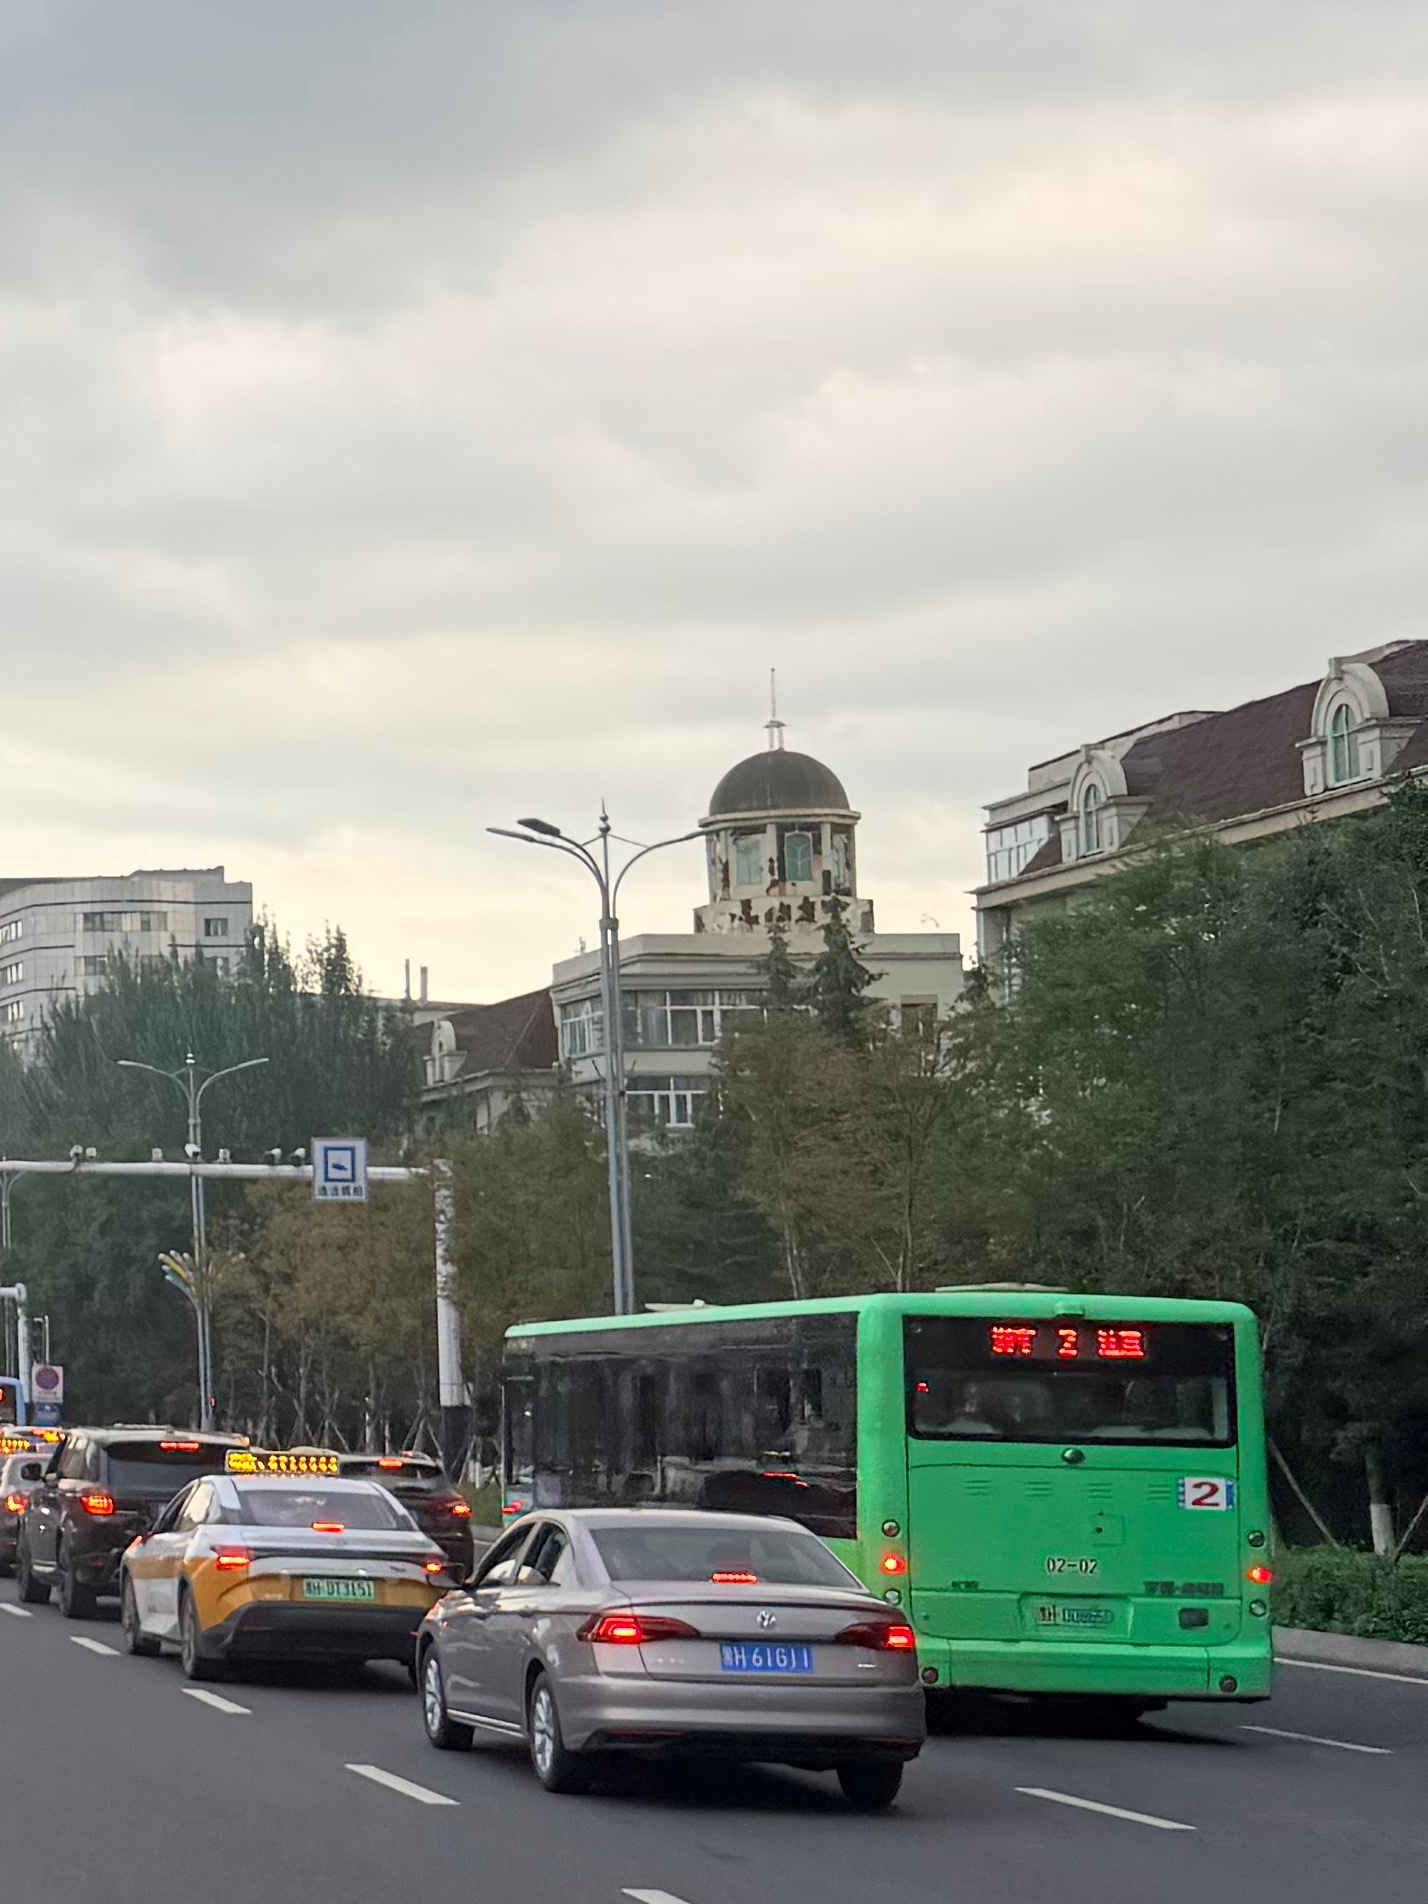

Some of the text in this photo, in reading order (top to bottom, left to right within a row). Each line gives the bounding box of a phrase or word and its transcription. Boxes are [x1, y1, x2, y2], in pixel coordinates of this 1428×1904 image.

[1056, 1327, 1078, 1358] 2
[1192, 1482, 1220, 1507] 2
[1046, 1557, 1098, 1574] 02-02
